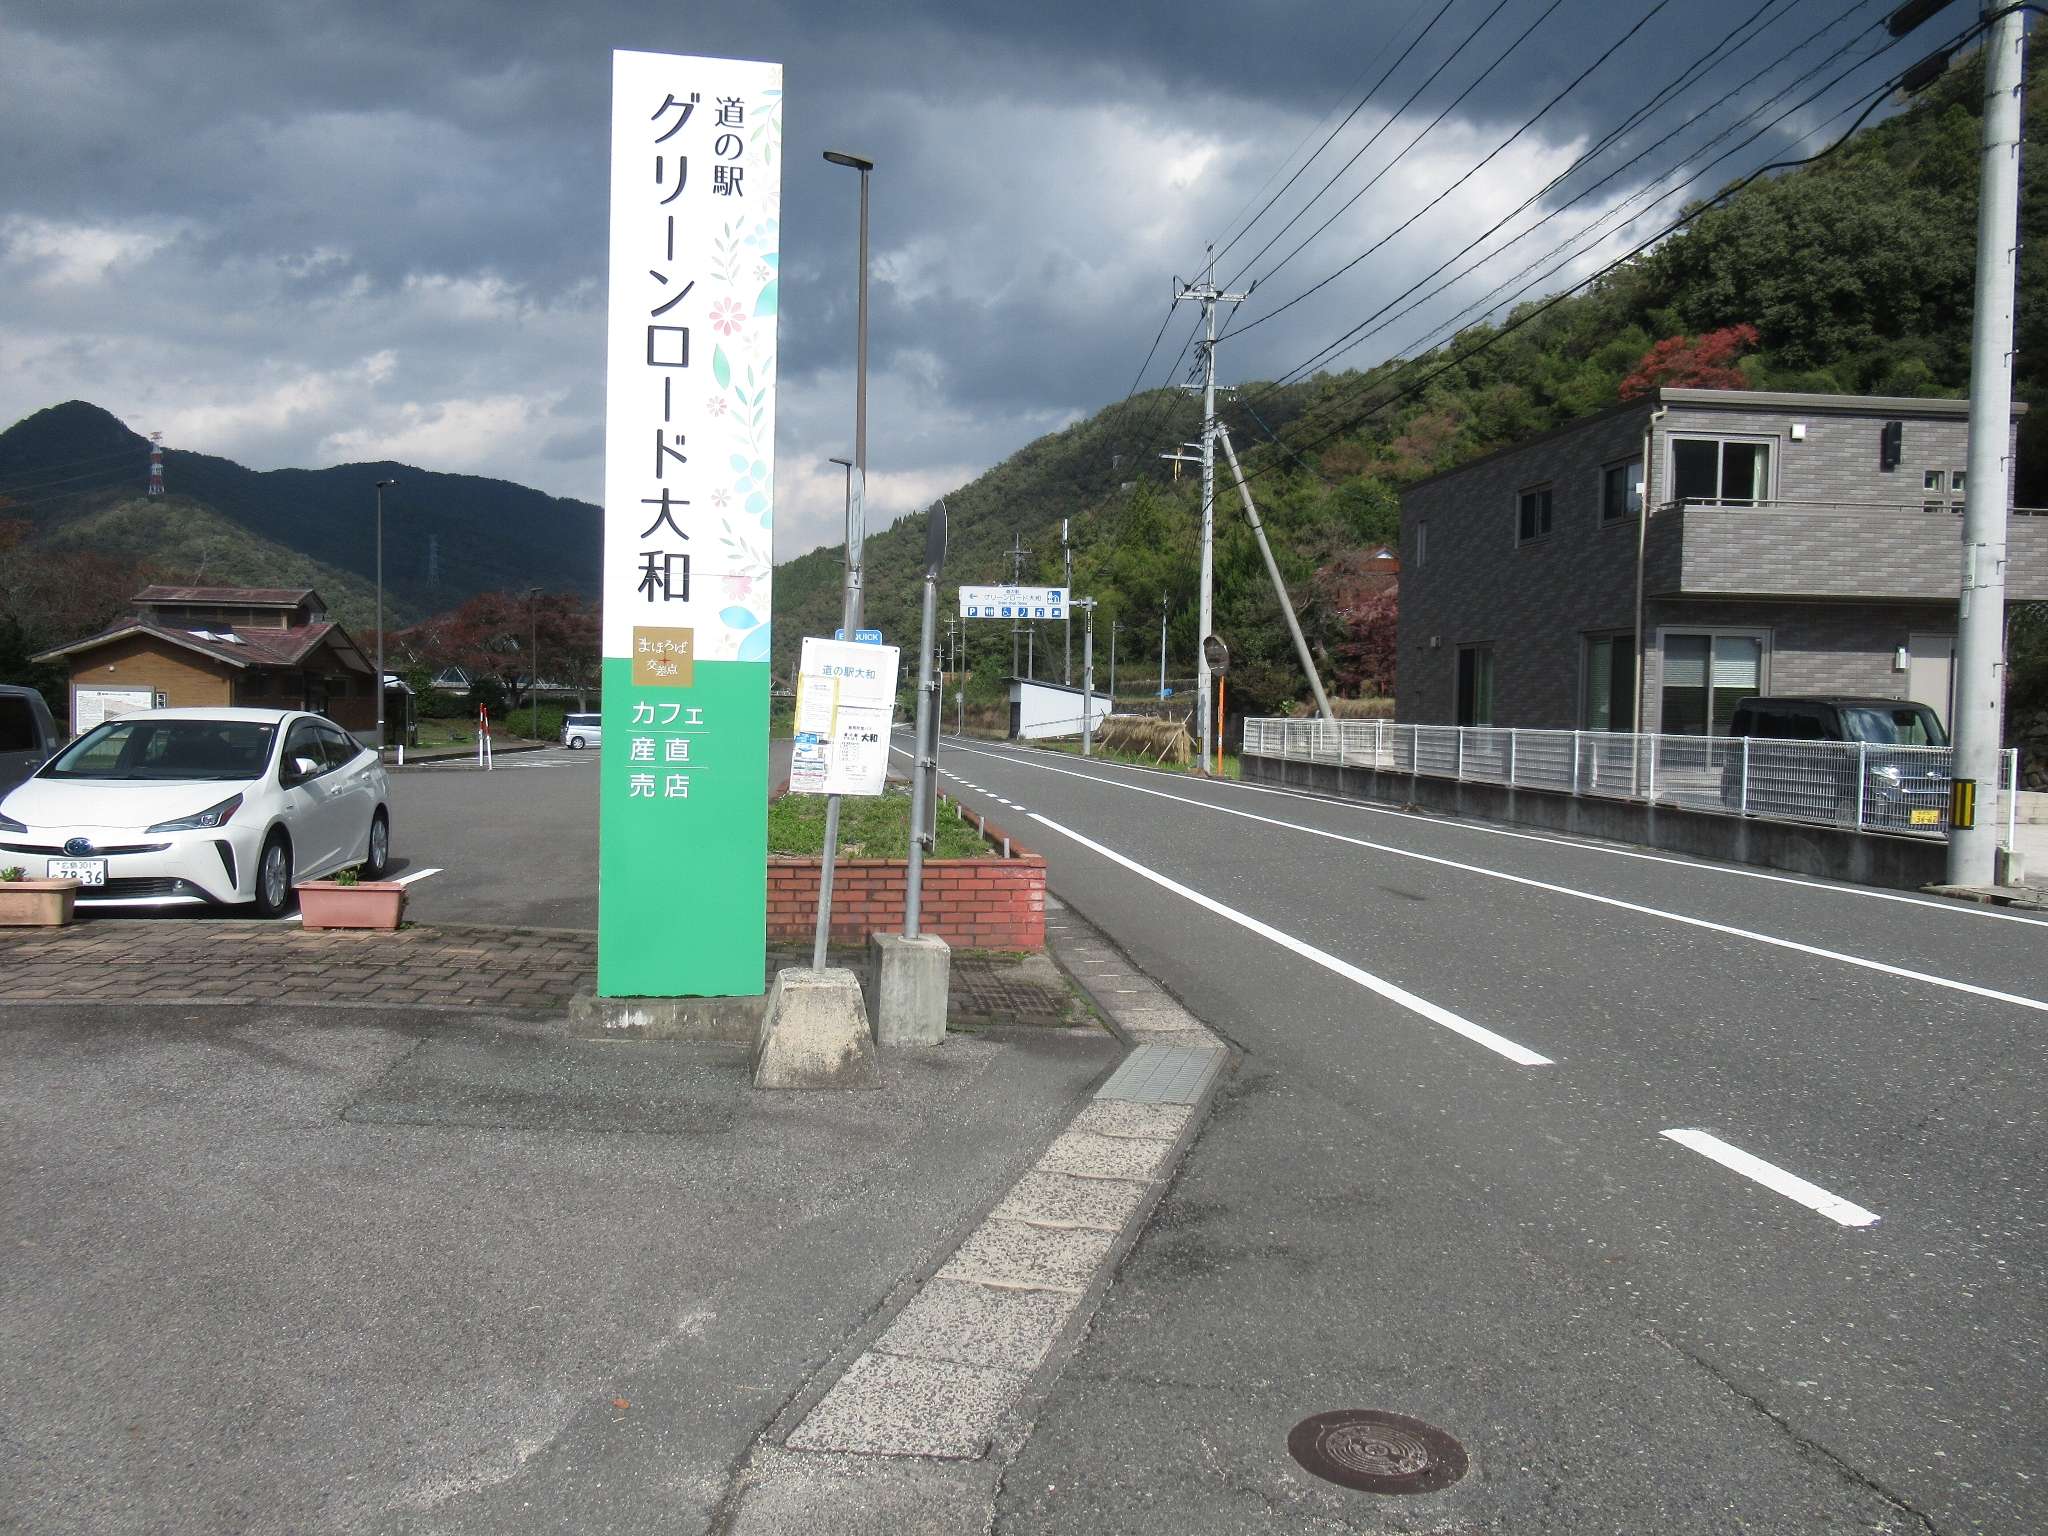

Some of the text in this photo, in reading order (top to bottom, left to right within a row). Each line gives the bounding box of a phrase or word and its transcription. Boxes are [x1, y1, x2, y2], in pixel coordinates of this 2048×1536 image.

[713, 97, 746, 197] 道の駅
[638, 92, 700, 603] グリーンロード大和
[638, 636, 689, 654] まほろば
[646, 659, 678, 677] 交差点
[821, 665, 876, 679] 道の駅大和
[631, 701, 704, 725] カフェ
[630, 736, 691, 762] 産直
[861, 733, 879, 743] 大和
[629, 773, 690, 799] 売店
